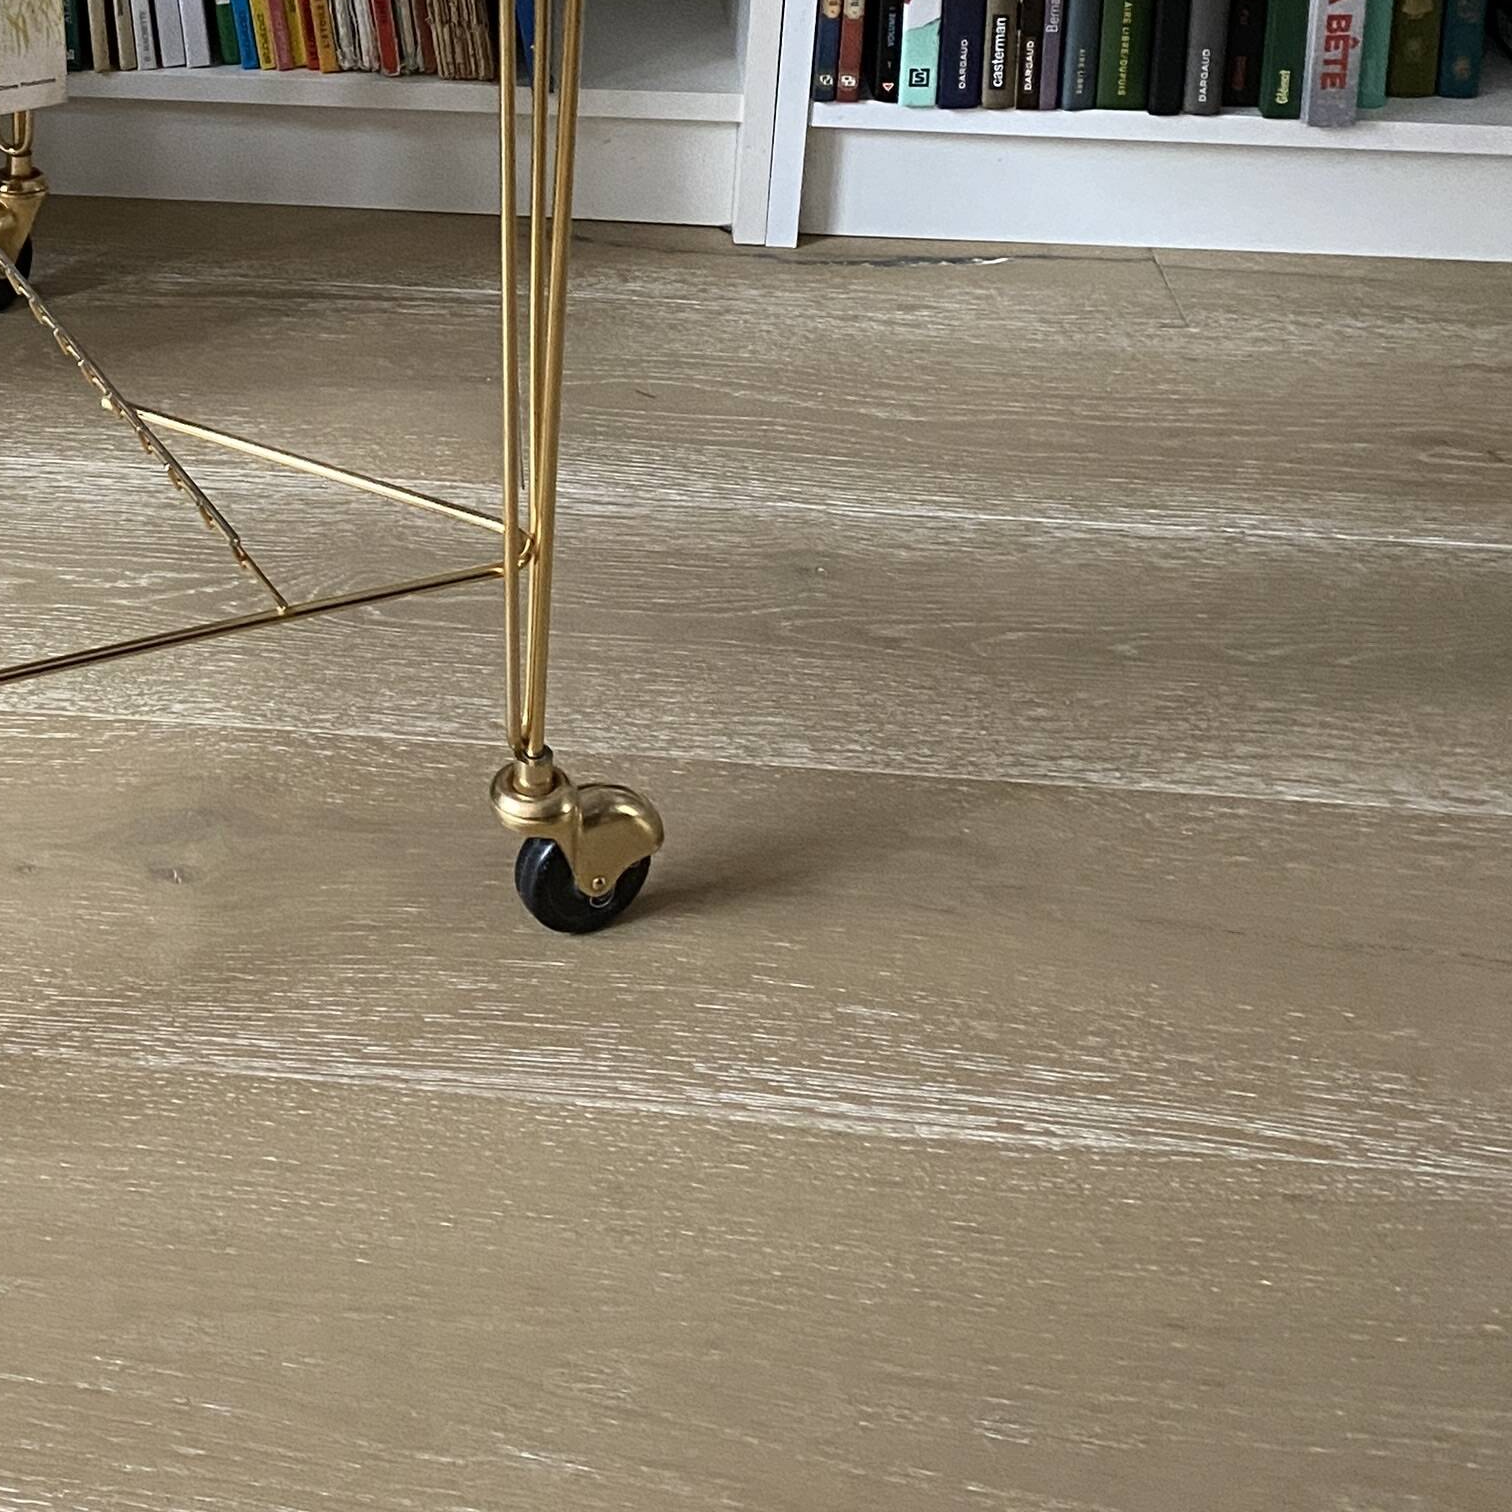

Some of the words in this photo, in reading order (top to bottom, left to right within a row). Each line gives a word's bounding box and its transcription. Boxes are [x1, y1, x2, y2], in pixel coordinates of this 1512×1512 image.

[957, 38, 969, 89] DARGAUD
[992, 16, 1008, 87] casterman
[1024, 40, 1035, 91] DARGAUD
[1198, 48, 1211, 103] DARGAUD
[1319, 13, 1361, 90] BÊTE
